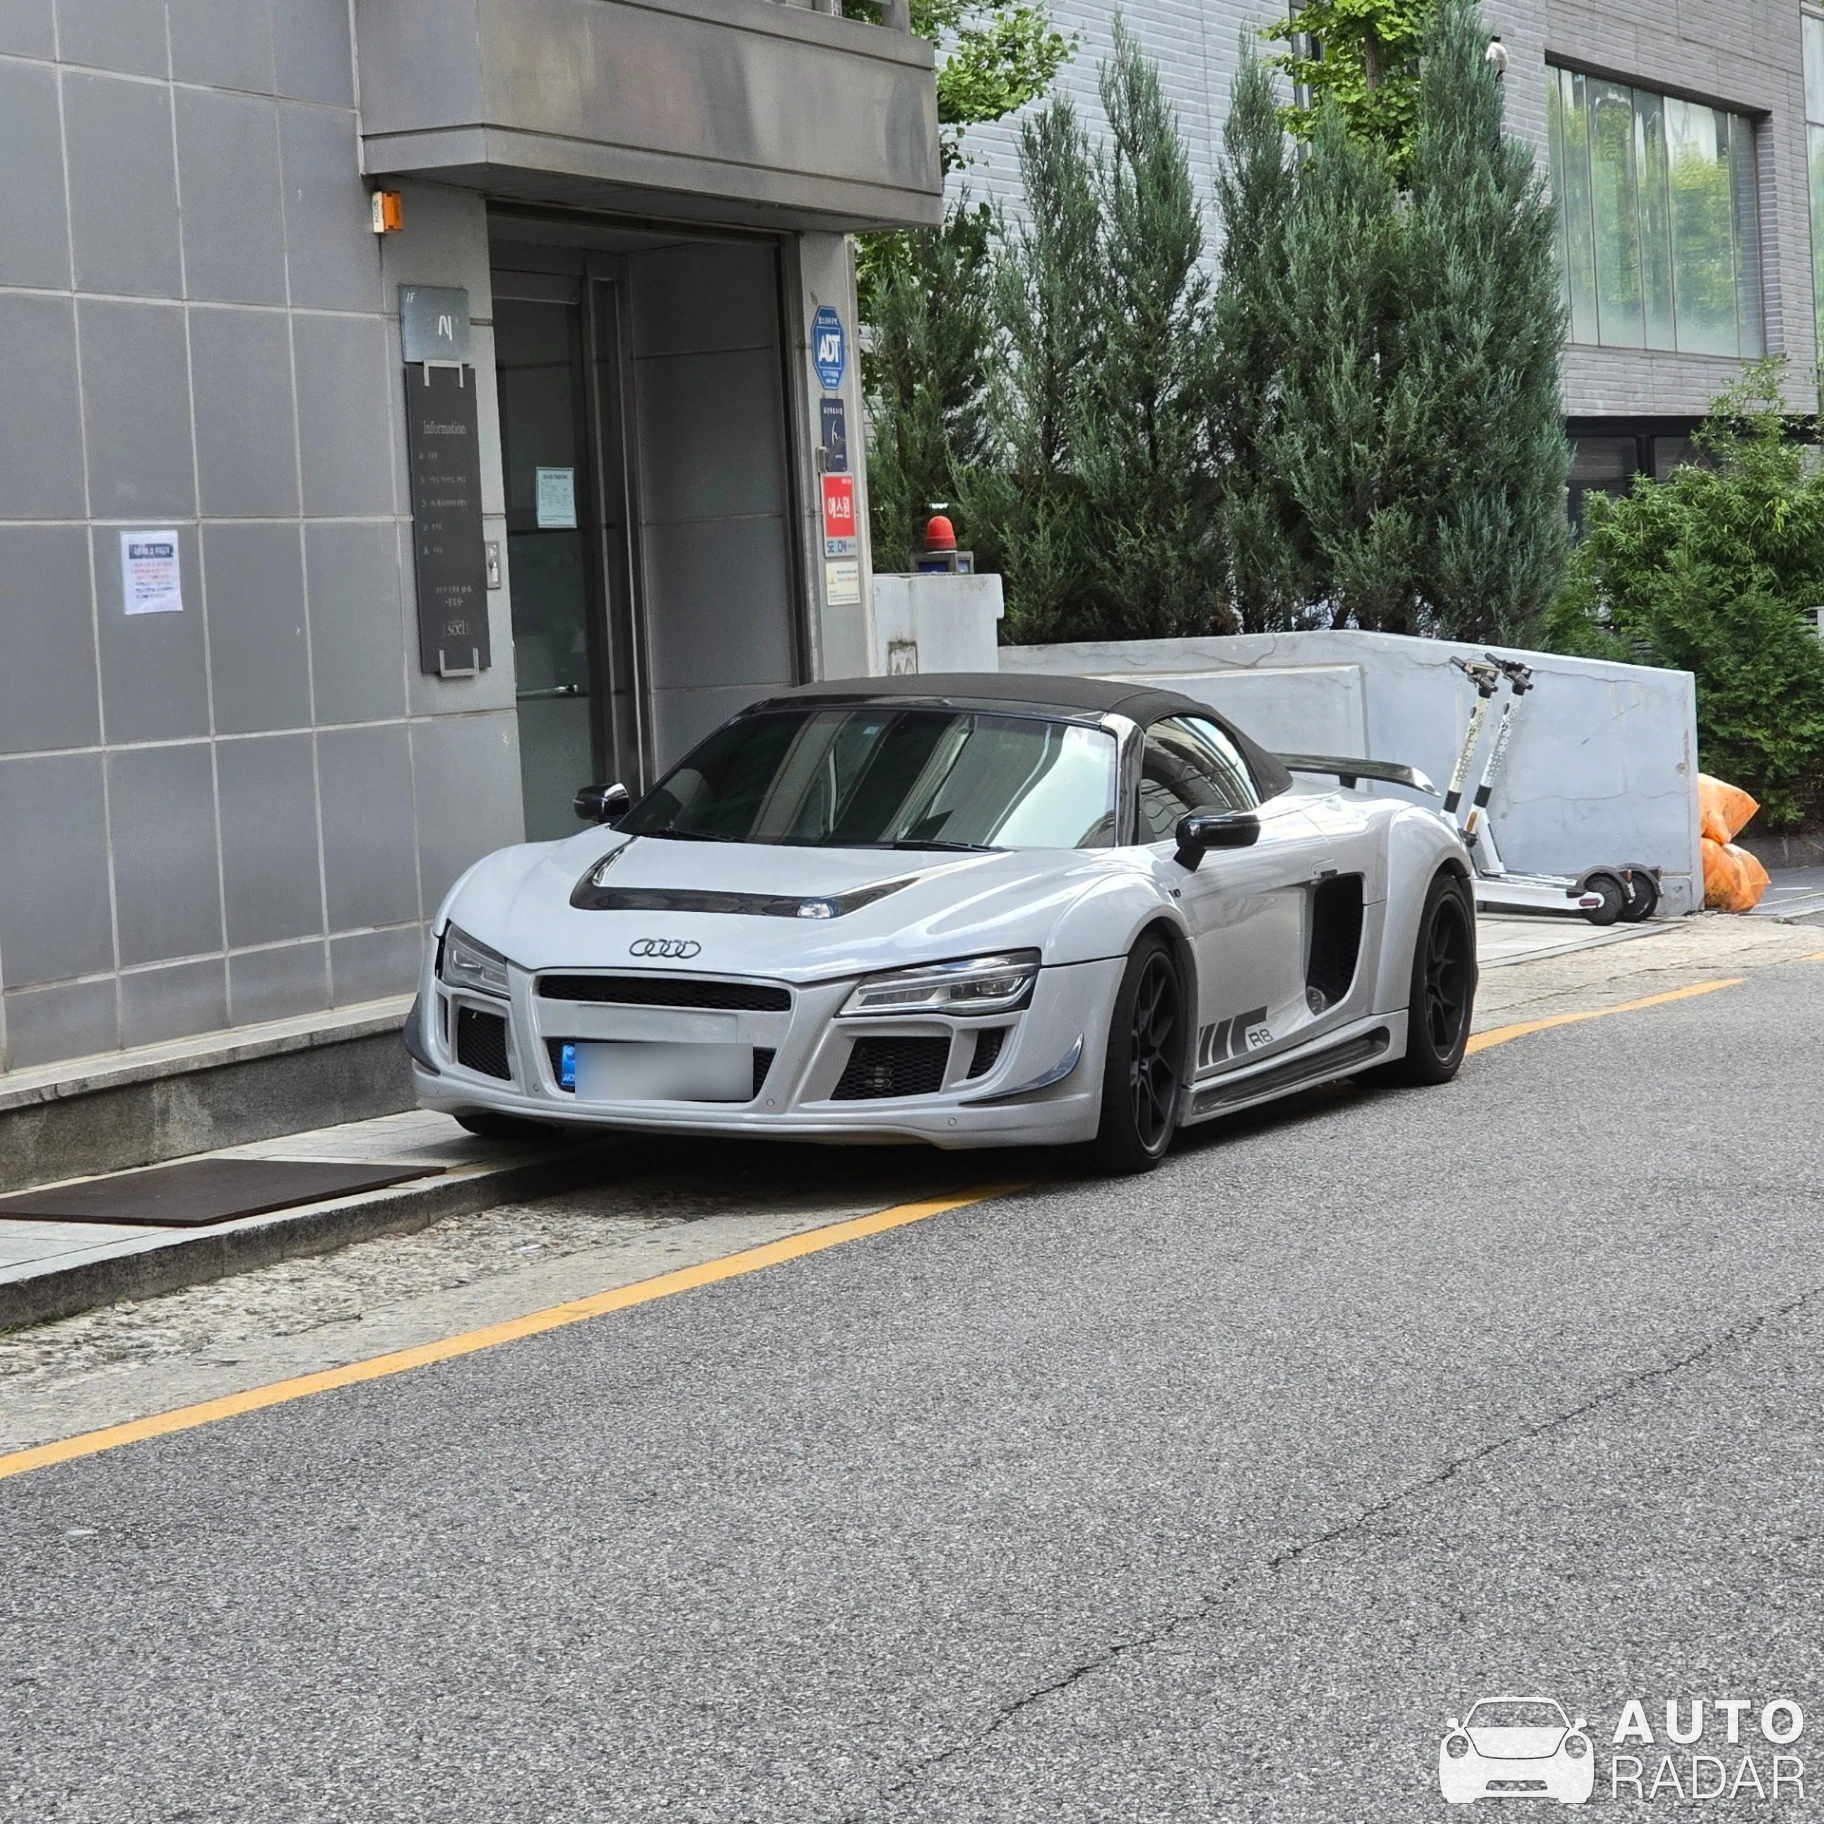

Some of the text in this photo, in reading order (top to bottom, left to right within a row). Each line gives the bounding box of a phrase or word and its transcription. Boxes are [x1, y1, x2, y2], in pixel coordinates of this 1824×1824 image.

[818, 333, 840, 363] ADT
[423, 420, 467, 435] Information
[828, 496, 851, 519] 에스원
[1248, 1028, 1274, 1047] R8
